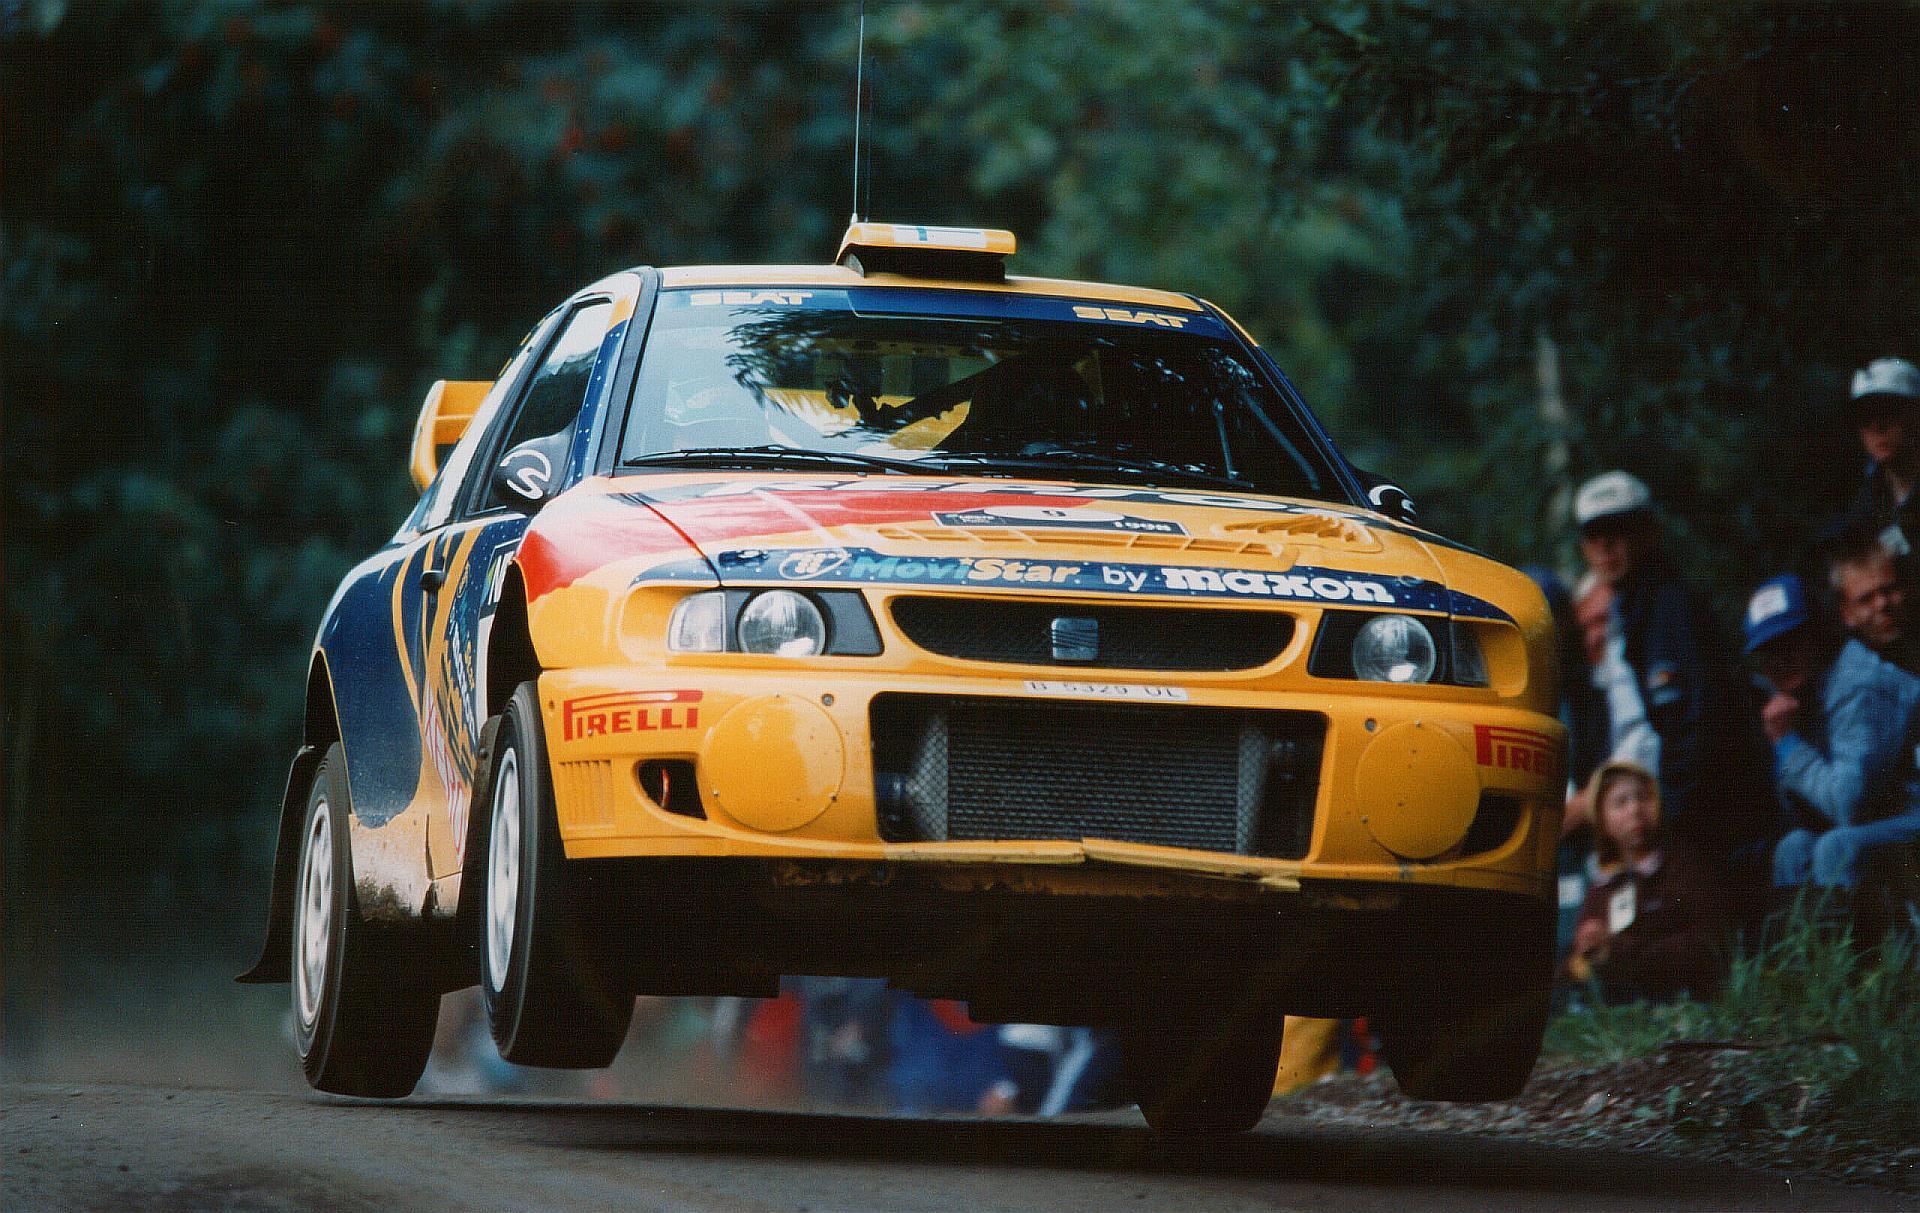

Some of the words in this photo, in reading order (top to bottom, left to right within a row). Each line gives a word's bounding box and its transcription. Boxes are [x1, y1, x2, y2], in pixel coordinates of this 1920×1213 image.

[690, 291, 814, 306] SEAT
[1072, 306, 1189, 328] SEAT
[850, 557, 1081, 583] MoviStar
[1102, 565, 1147, 592] by
[1160, 566, 1396, 604] maxon
[563, 689, 704, 742] PIRELLI
